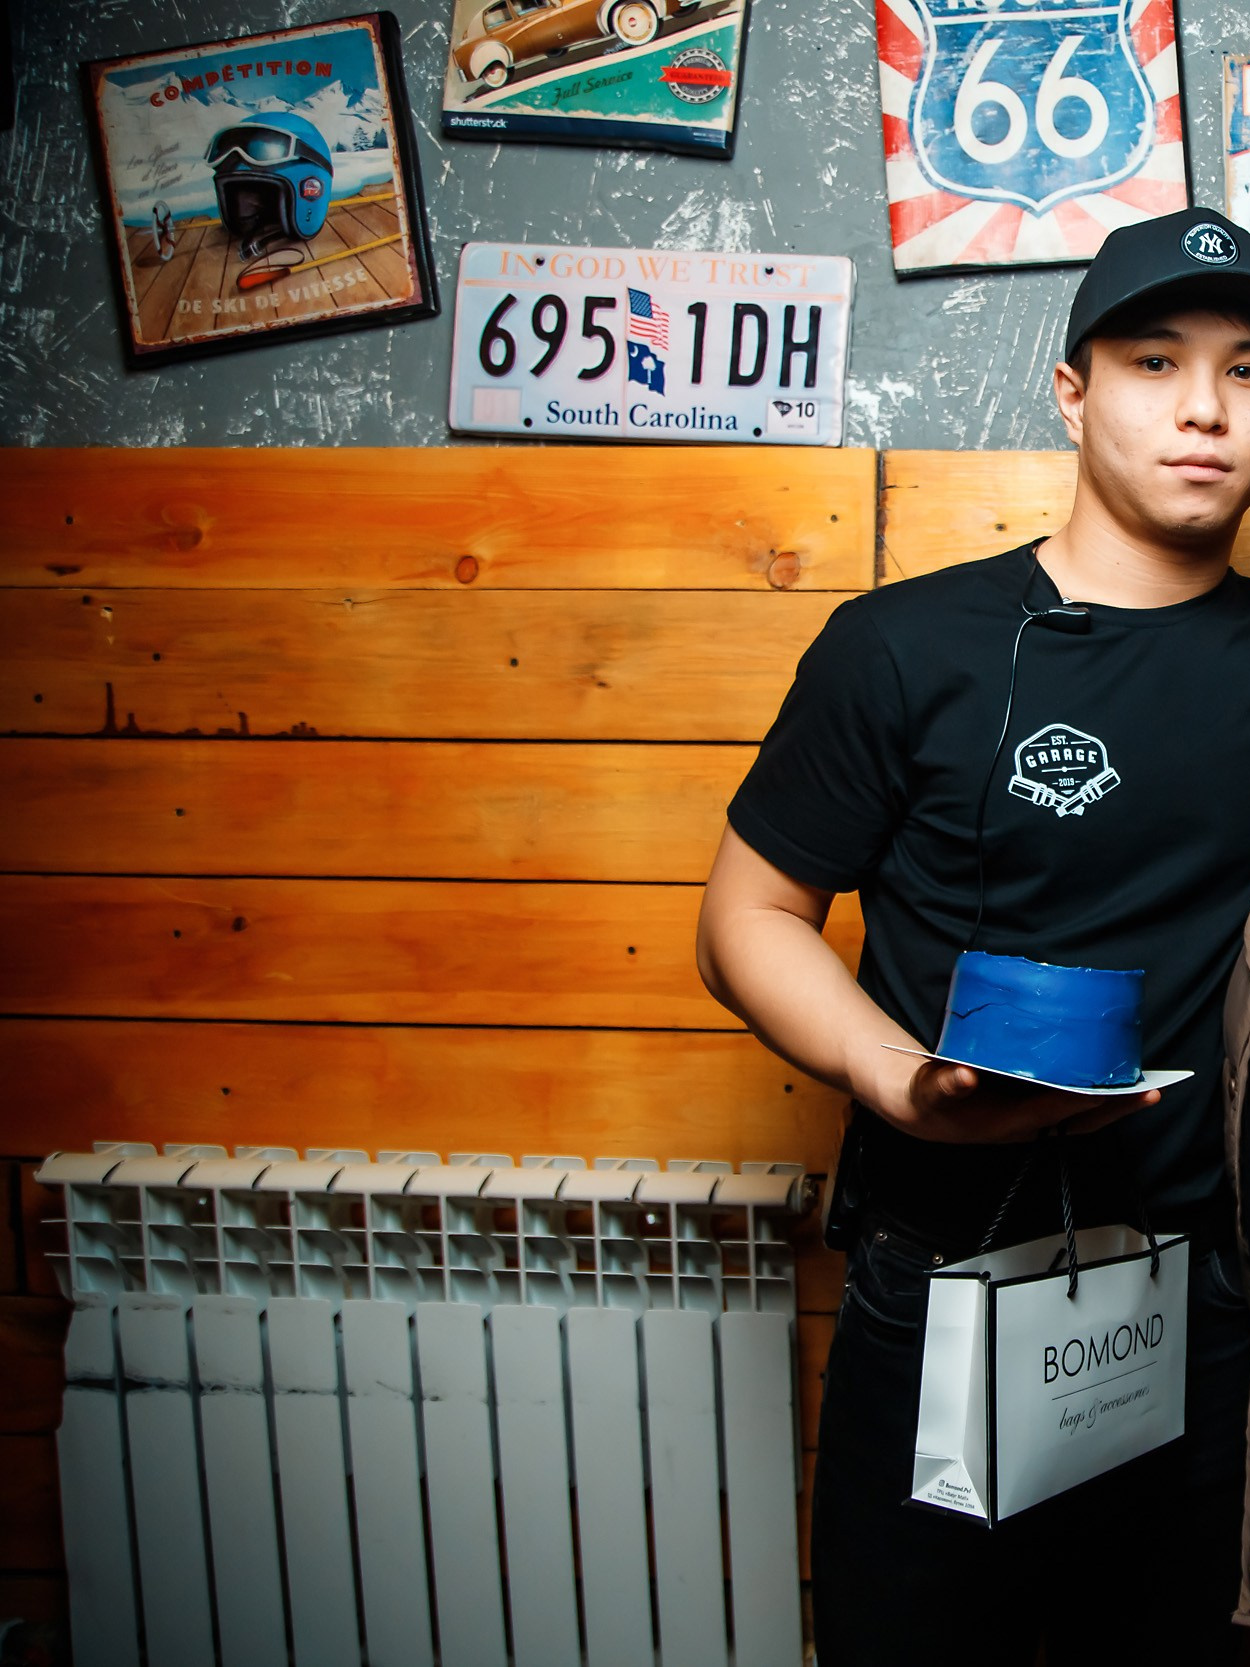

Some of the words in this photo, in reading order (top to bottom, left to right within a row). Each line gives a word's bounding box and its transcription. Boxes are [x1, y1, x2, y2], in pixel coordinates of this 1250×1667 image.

[551, 81, 581, 106] Full
[583, 70, 633, 94] Service
[953, 35, 1110, 164] 66
[1199, 232, 1224, 254] NY
[499, 250, 537, 278] IN
[549, 252, 626, 280] GOD
[635, 255, 691, 283] WE
[699, 258, 818, 289] TRUST
[177, 299, 202, 315] DE
[212, 298, 247, 314] SKI
[255, 293, 280, 311] DE
[288, 268, 368, 304] VITESSE
[477, 293, 618, 381] 695
[687, 301, 823, 389] 1DH
[546, 401, 621, 427] South
[628, 403, 739, 432] Carolina
[796, 402, 815, 418] 10
[1051, 735, 1069, 746] EST.
[1025, 748, 1098, 768] GARAGE
[1044, 1313, 1164, 1385] BOMOND
[1059, 1407, 1086, 1436] bags
